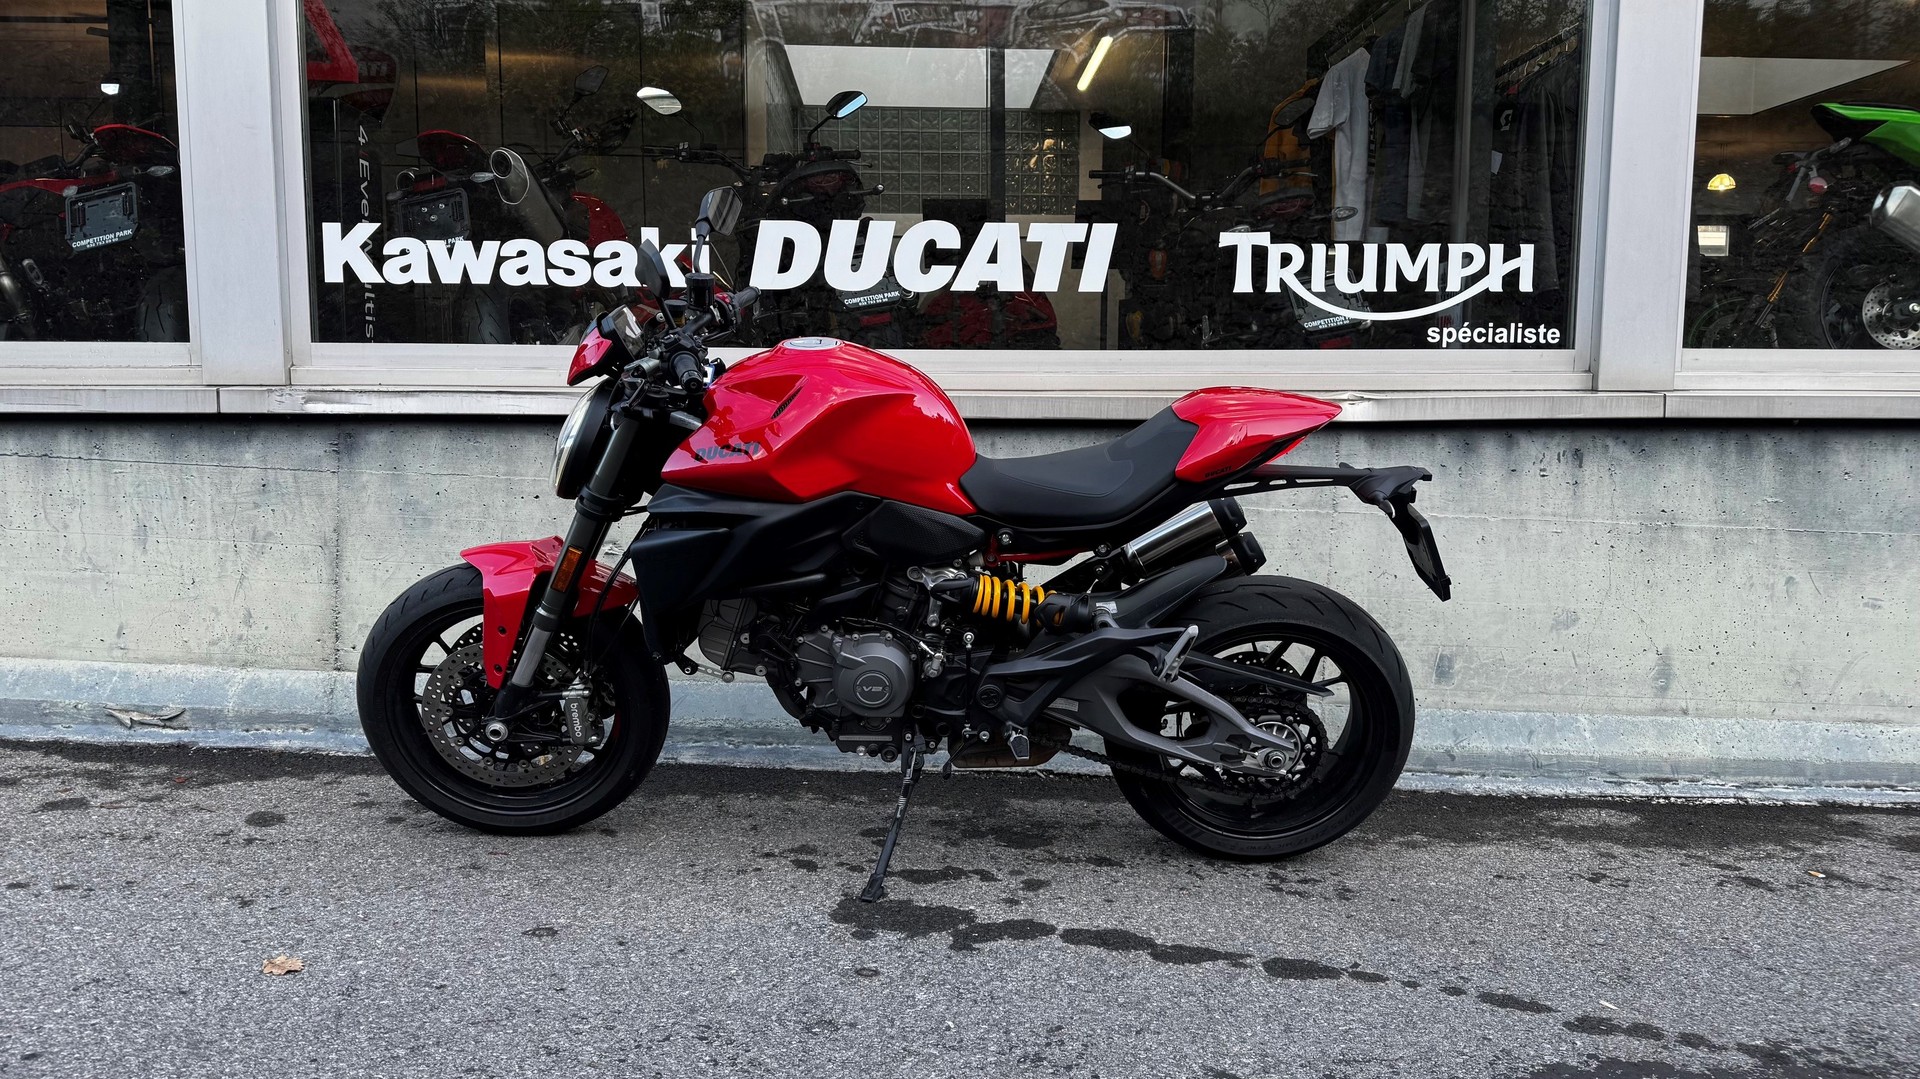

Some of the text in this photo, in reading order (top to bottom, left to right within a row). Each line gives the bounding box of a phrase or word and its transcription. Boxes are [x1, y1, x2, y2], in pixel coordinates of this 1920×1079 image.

[359, 158, 371, 223] Eve
[72, 233, 115, 248] COMPETITION
[115, 228, 133, 238] PARK
[321, 222, 711, 288] Kawasaki
[749, 219, 1118, 292] DUCATI
[1218, 231, 1535, 320] TRIUMPH
[844, 293, 884, 305] COMPETITION
[884, 290, 900, 298] PARK
[1303, 316, 1345, 328] COMPETITION
[1427, 322, 1560, 347] spécialiste
[695, 442, 760, 462] DUCATI
[570, 702, 582, 737] brembo
